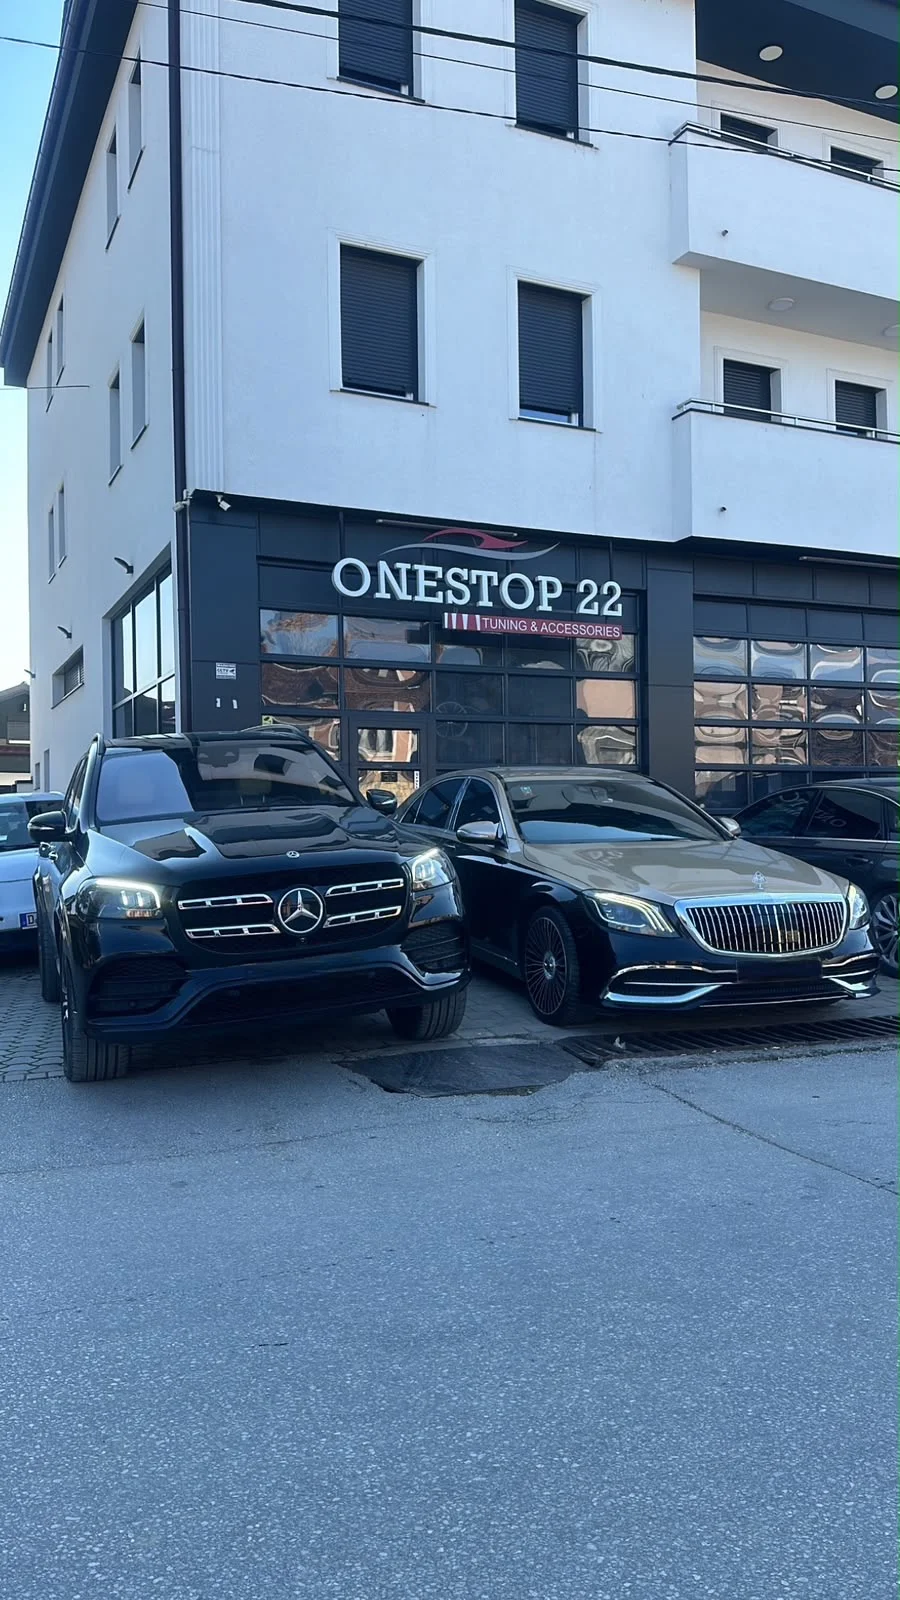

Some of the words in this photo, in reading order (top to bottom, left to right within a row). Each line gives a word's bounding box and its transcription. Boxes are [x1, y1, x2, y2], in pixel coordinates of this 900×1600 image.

[331, 557, 562, 612] ONESTOP
[576, 578, 622, 617] 22
[482, 617, 528, 631] TUNING
[530, 621, 538, 632] &
[540, 623, 620, 638] ACCESSORIES
